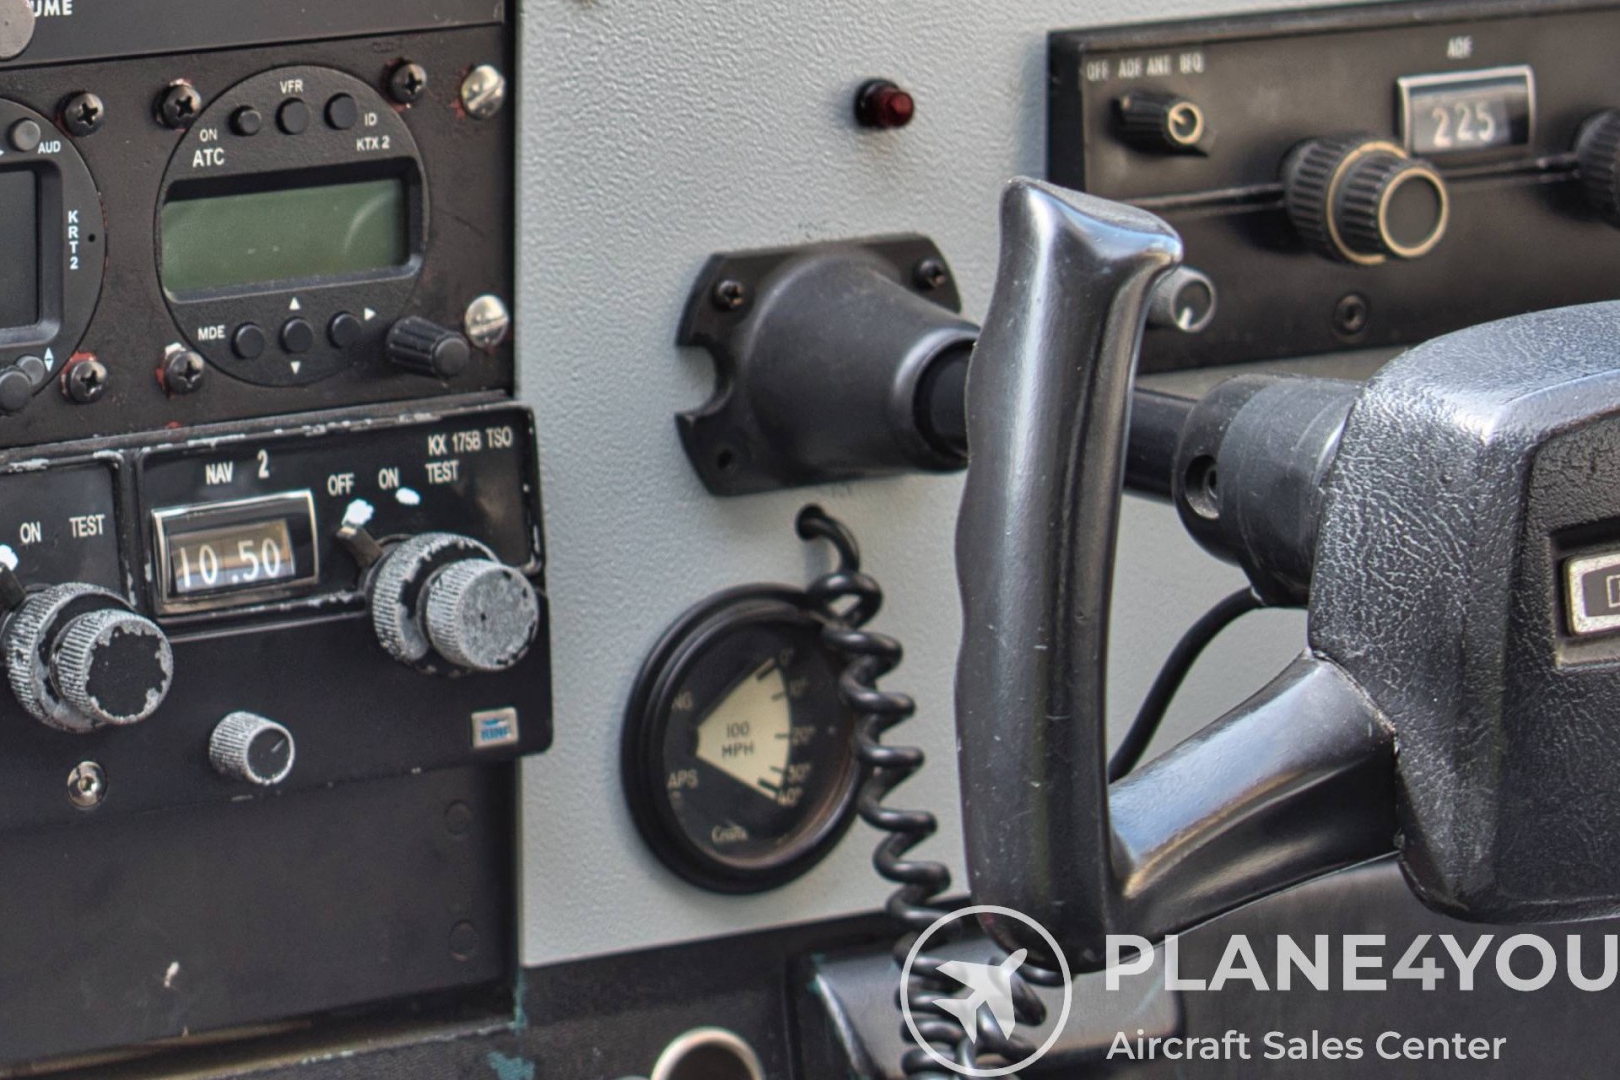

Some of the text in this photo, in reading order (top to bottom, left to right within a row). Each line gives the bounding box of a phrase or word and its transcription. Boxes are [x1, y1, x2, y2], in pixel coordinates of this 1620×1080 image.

[1447, 37, 1473, 58] ADF
[1087, 61, 1109, 81] OFF
[1118, 57, 1141, 78] ADF
[281, 80, 303, 93] VFR
[364, 113, 377, 126] ID
[1431, 101, 1495, 147] 225
[199, 129, 218, 141] ON
[38, 142, 61, 154] AUD
[356, 137, 379, 151] KTX
[192, 148, 225, 168] ATC
[197, 325, 226, 340] MDE
[428, 426, 513, 455] KX 175B TSO
[206, 450, 269, 484] NAV 2
[328, 460, 459, 496] OFF ON TEST
[20, 522, 41, 543] ON
[69, 515, 105, 538] TEST
[727, 722, 749, 737] 100
[722, 743, 754, 757] MPH
